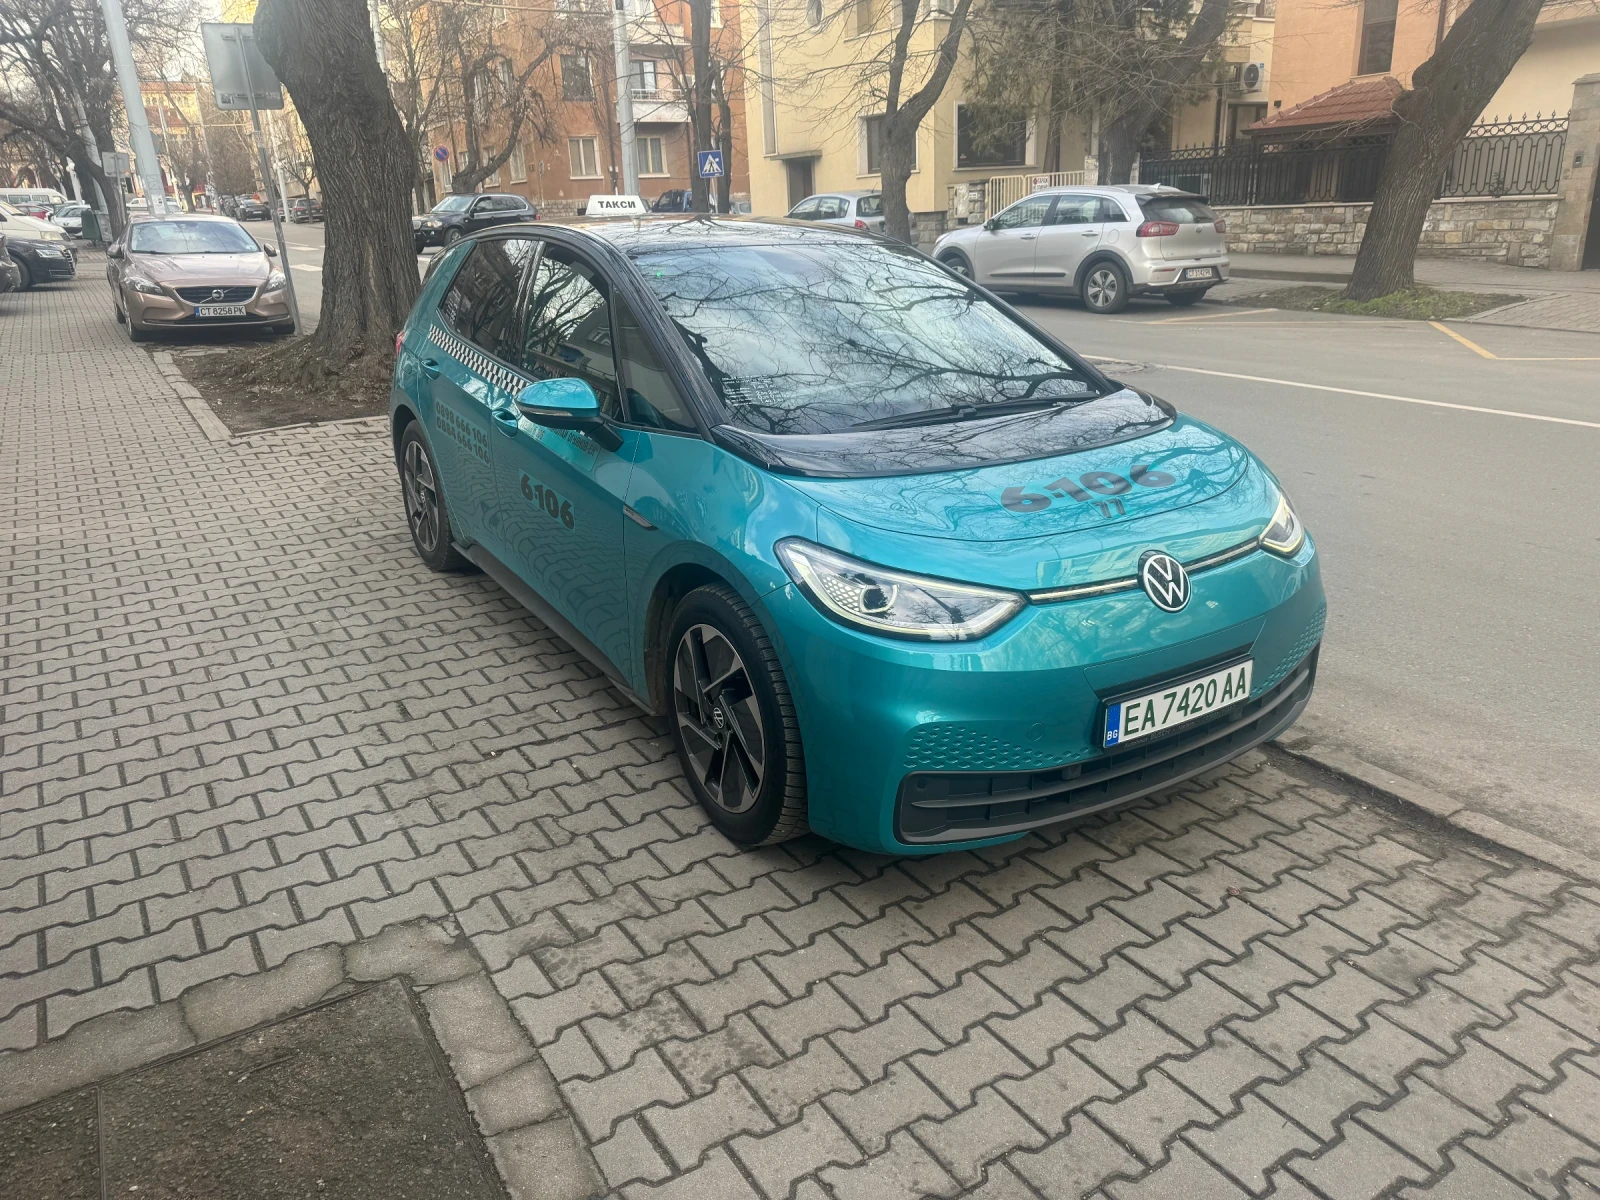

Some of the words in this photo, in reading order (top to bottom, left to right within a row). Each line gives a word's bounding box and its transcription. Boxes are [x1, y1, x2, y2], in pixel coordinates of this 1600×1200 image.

[597, 200, 636, 209] ТАКСИ
[200, 307, 211, 316] CT
[213, 306, 232, 316] 8258
[233, 306, 245, 315] PK
[436, 401, 455, 424] 0898
[456, 415, 471, 436] 666
[472, 427, 488, 448] 106
[436, 416, 457, 440] 0884
[457, 431, 473, 451] 666
[473, 444, 490, 464] 106
[1143, 554, 1191, 611] VW
[1123, 698, 1156, 737] EA
[1161, 678, 1217, 725] 7420
[1221, 666, 1246, 703] AA
[1107, 729, 1119, 741] BG
